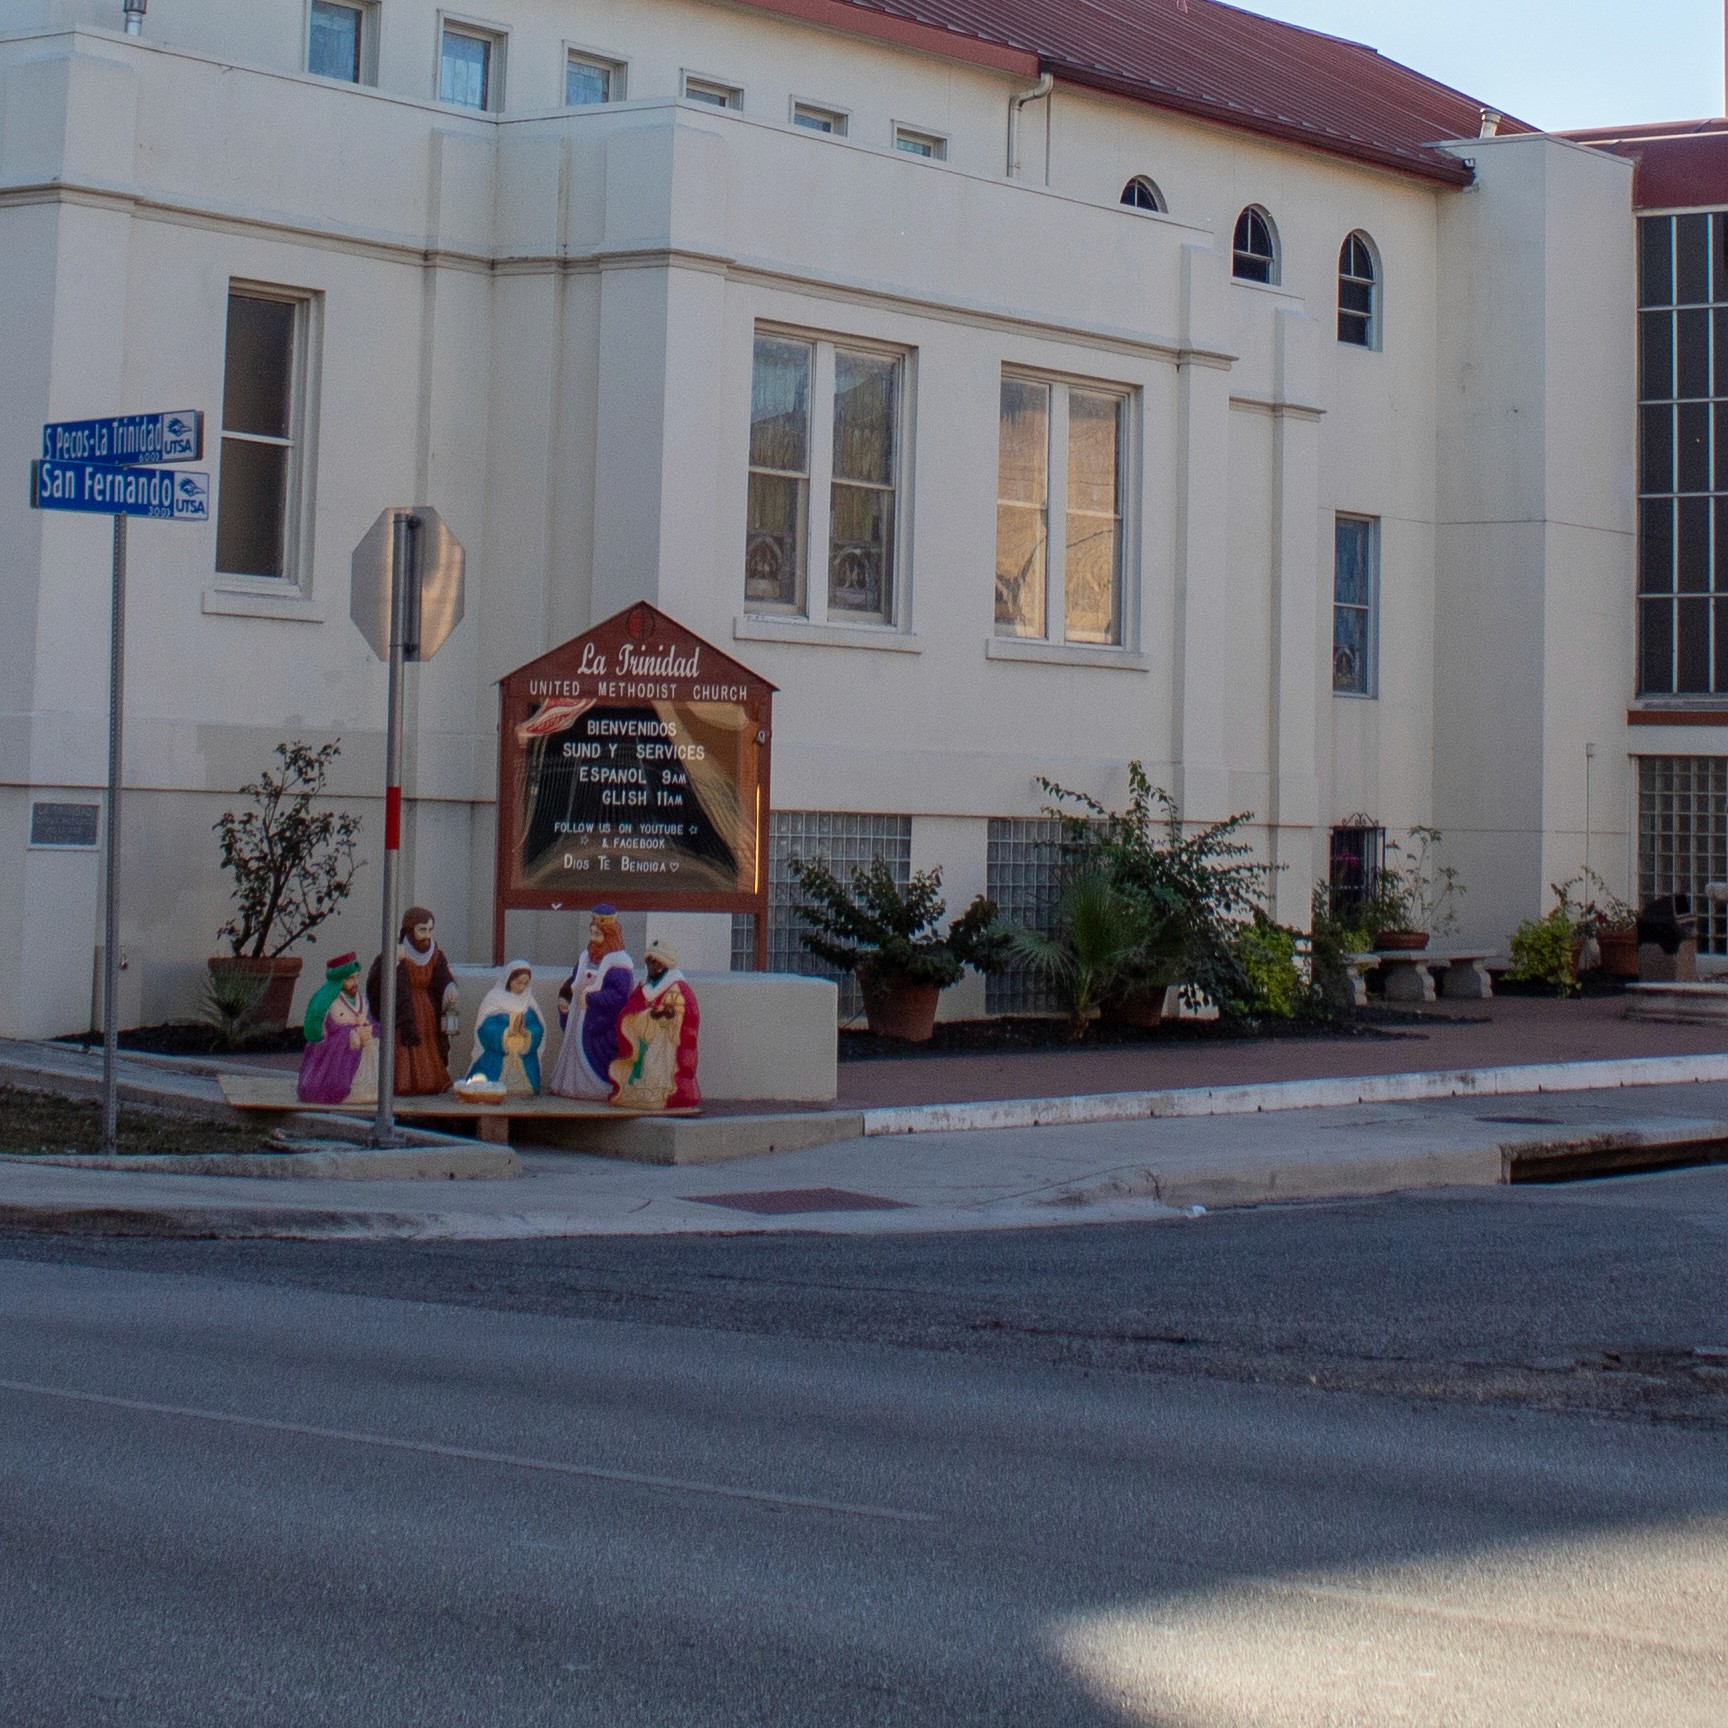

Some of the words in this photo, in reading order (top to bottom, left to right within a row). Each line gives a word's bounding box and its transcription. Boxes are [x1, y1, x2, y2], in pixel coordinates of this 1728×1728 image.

[44, 427, 53, 461] S
[56, 423, 108, 460] Pecos-La
[112, 415, 163, 455] Trinidad
[164, 439, 193, 455] UTSA
[41, 463, 76, 499] San
[84, 466, 173, 507] Fernando
[175, 499, 206, 515] UTSA
[577, 642, 607, 675] La
[615, 643, 701, 679] Trinidad
[529, 680, 581, 697] UNITED
[598, 681, 677, 699] METHODIST
[693, 685, 748, 701] CHURCH
[587, 720, 677, 737] BIENVENIDOS
[636, 744, 706, 761] SERVICES
[578, 766, 647, 785] ESPANOL
[602, 790, 647, 806] GLISH
[554, 822, 594, 834] FOLLOW
[599, 823, 611, 834] US
[618, 823, 632, 835] ON
[640, 823, 684, 835] YOUTUBE
[601, 837, 609, 849] &
[613, 837, 666, 849] FACEBOOK
